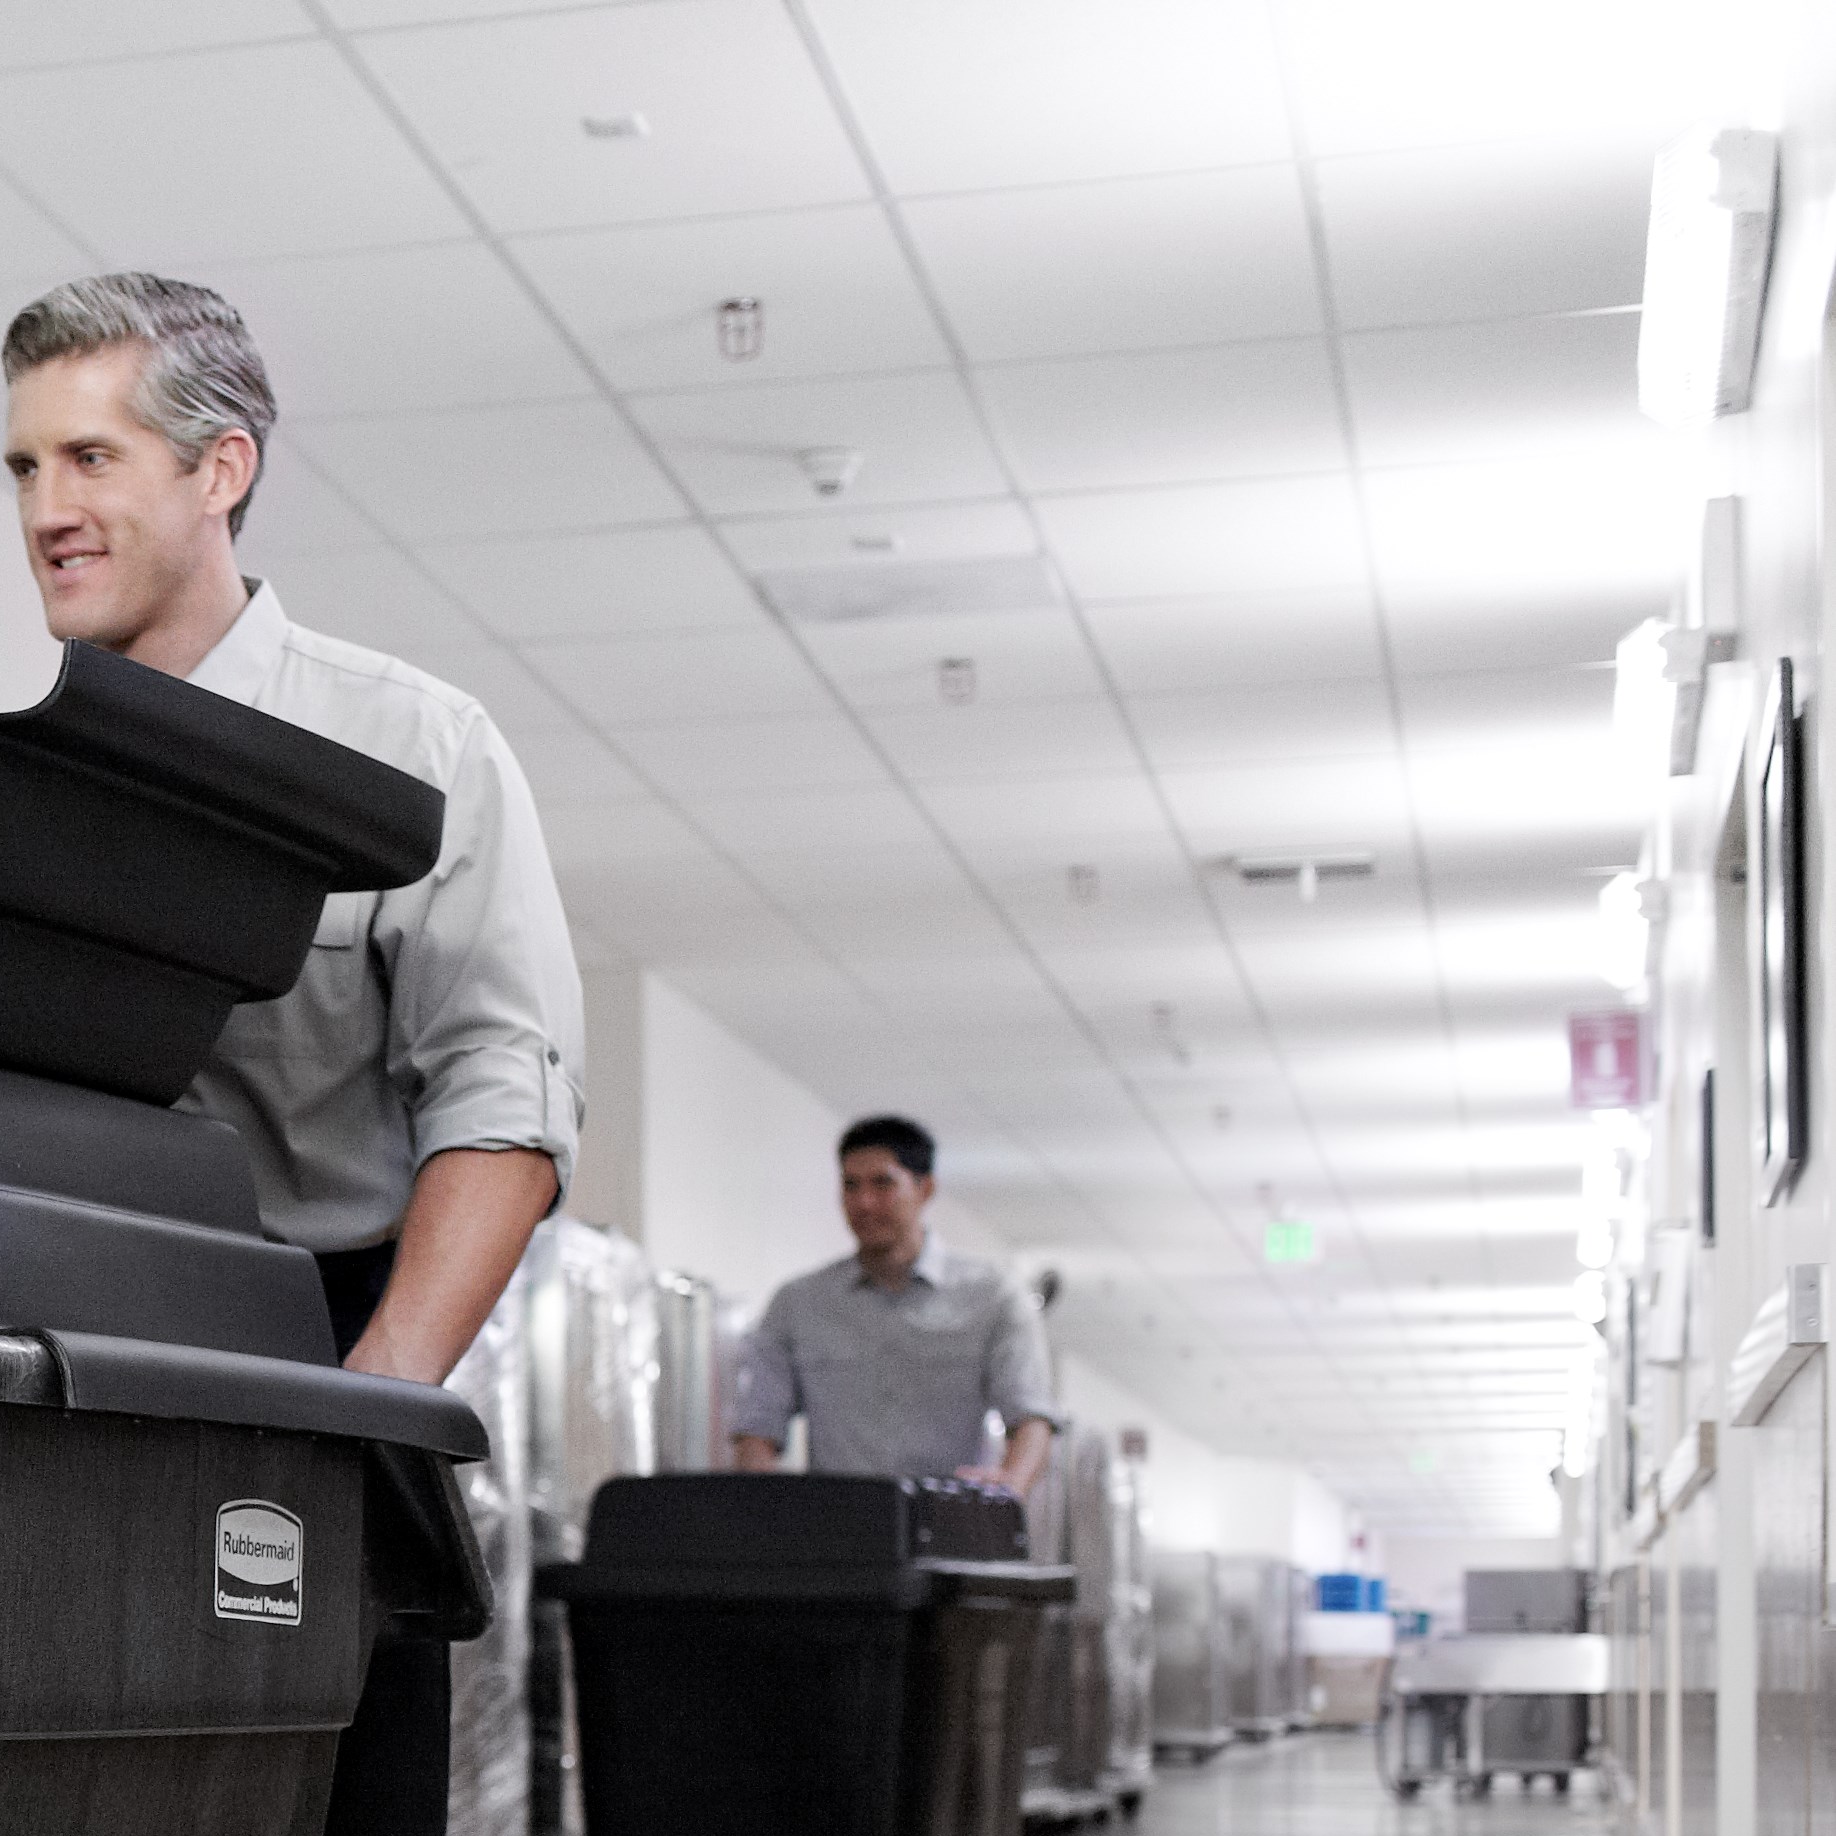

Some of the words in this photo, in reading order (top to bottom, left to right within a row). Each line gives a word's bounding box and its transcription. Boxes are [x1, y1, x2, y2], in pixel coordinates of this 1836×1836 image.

[223, 1531, 295, 1561] Rubbermaid
[218, 1591, 263, 1612] Commercial
[264, 1596, 298, 1617] Products
